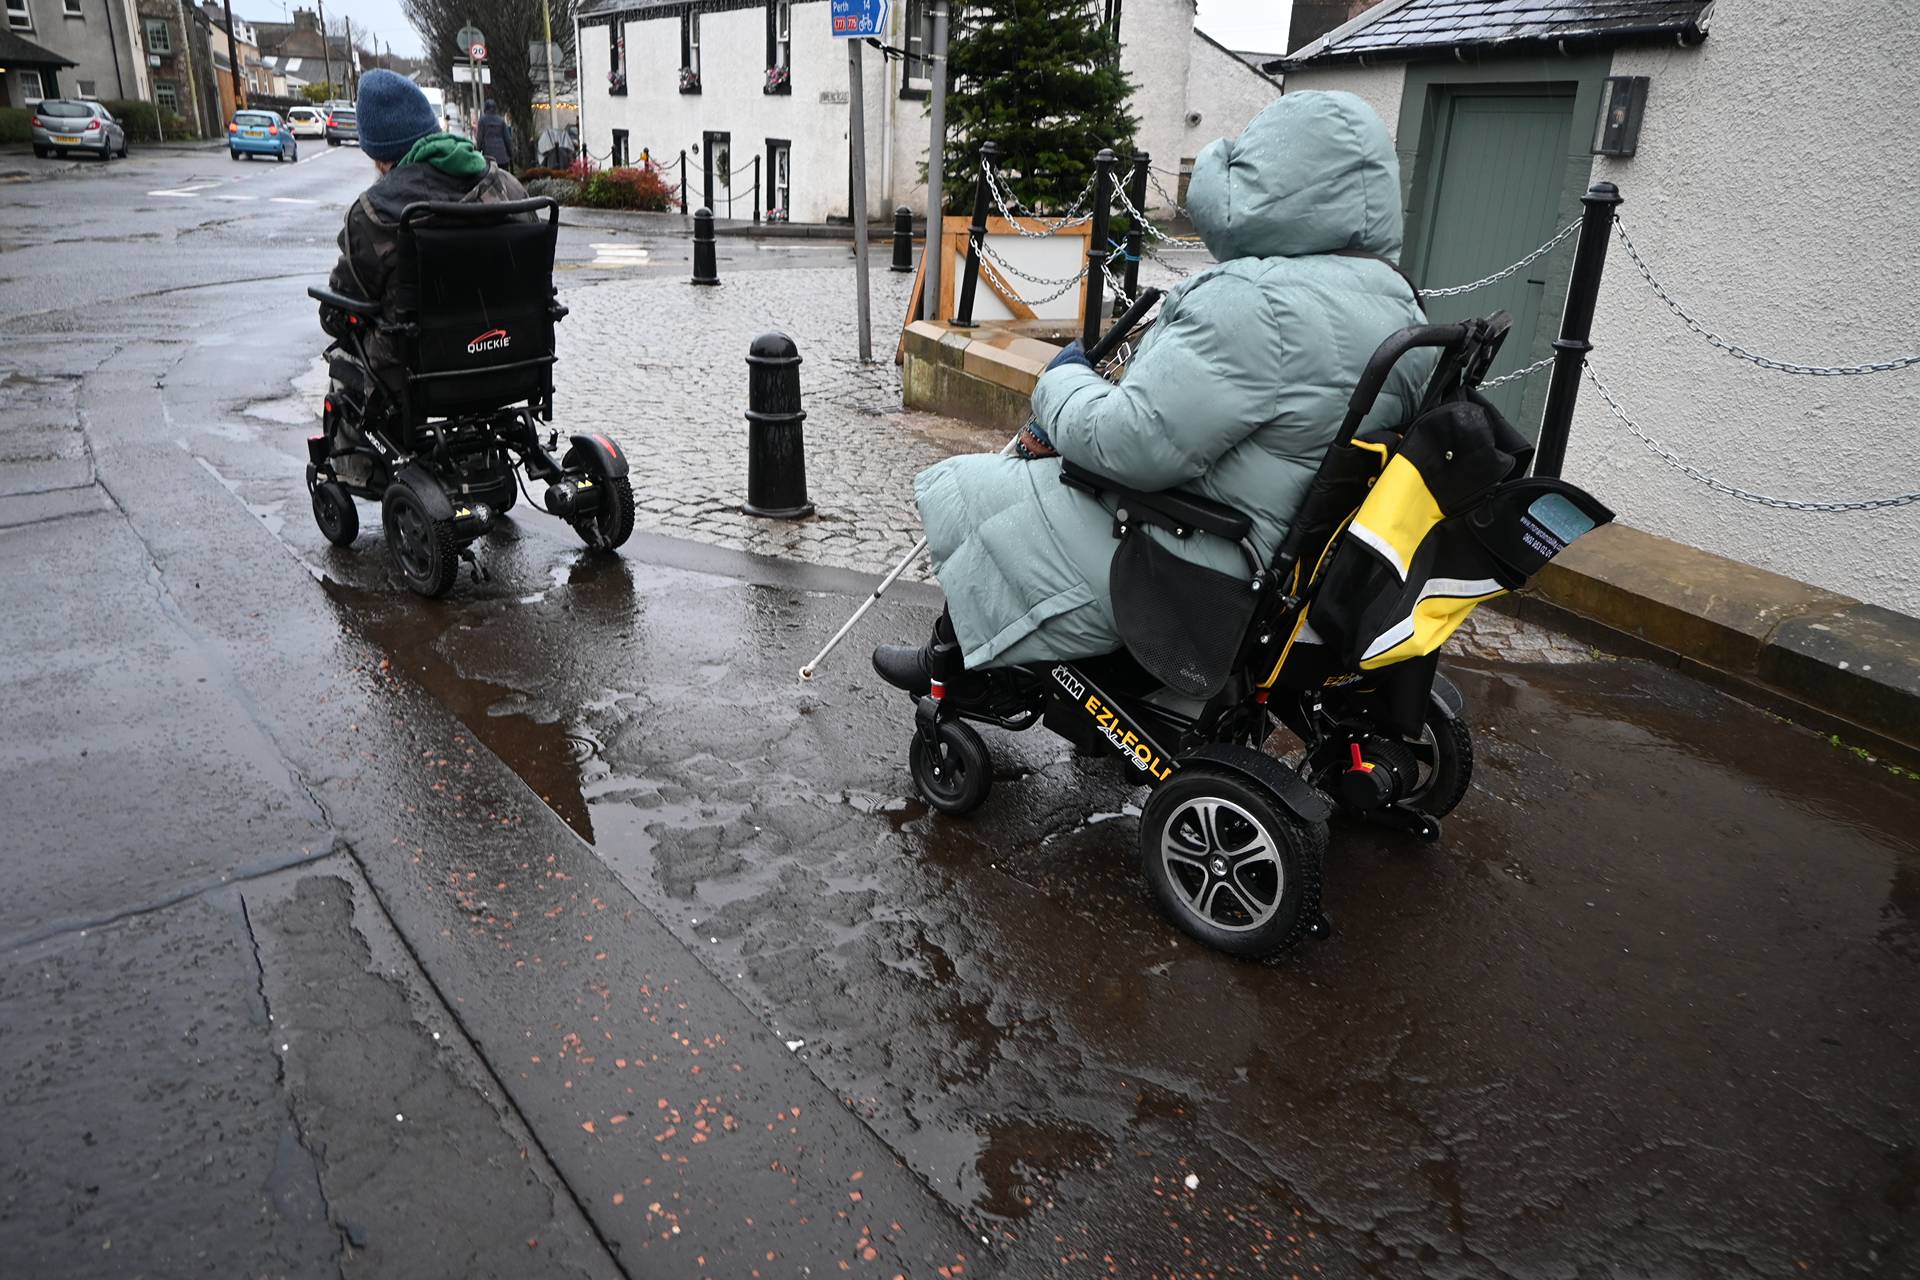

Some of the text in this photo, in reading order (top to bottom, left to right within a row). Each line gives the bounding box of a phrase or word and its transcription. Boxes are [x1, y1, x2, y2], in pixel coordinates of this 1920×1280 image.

[833, 0, 871, 12] Perth 14
[467, 336, 510, 354] QUICKIE
[1097, 725, 1149, 772] AUTO
